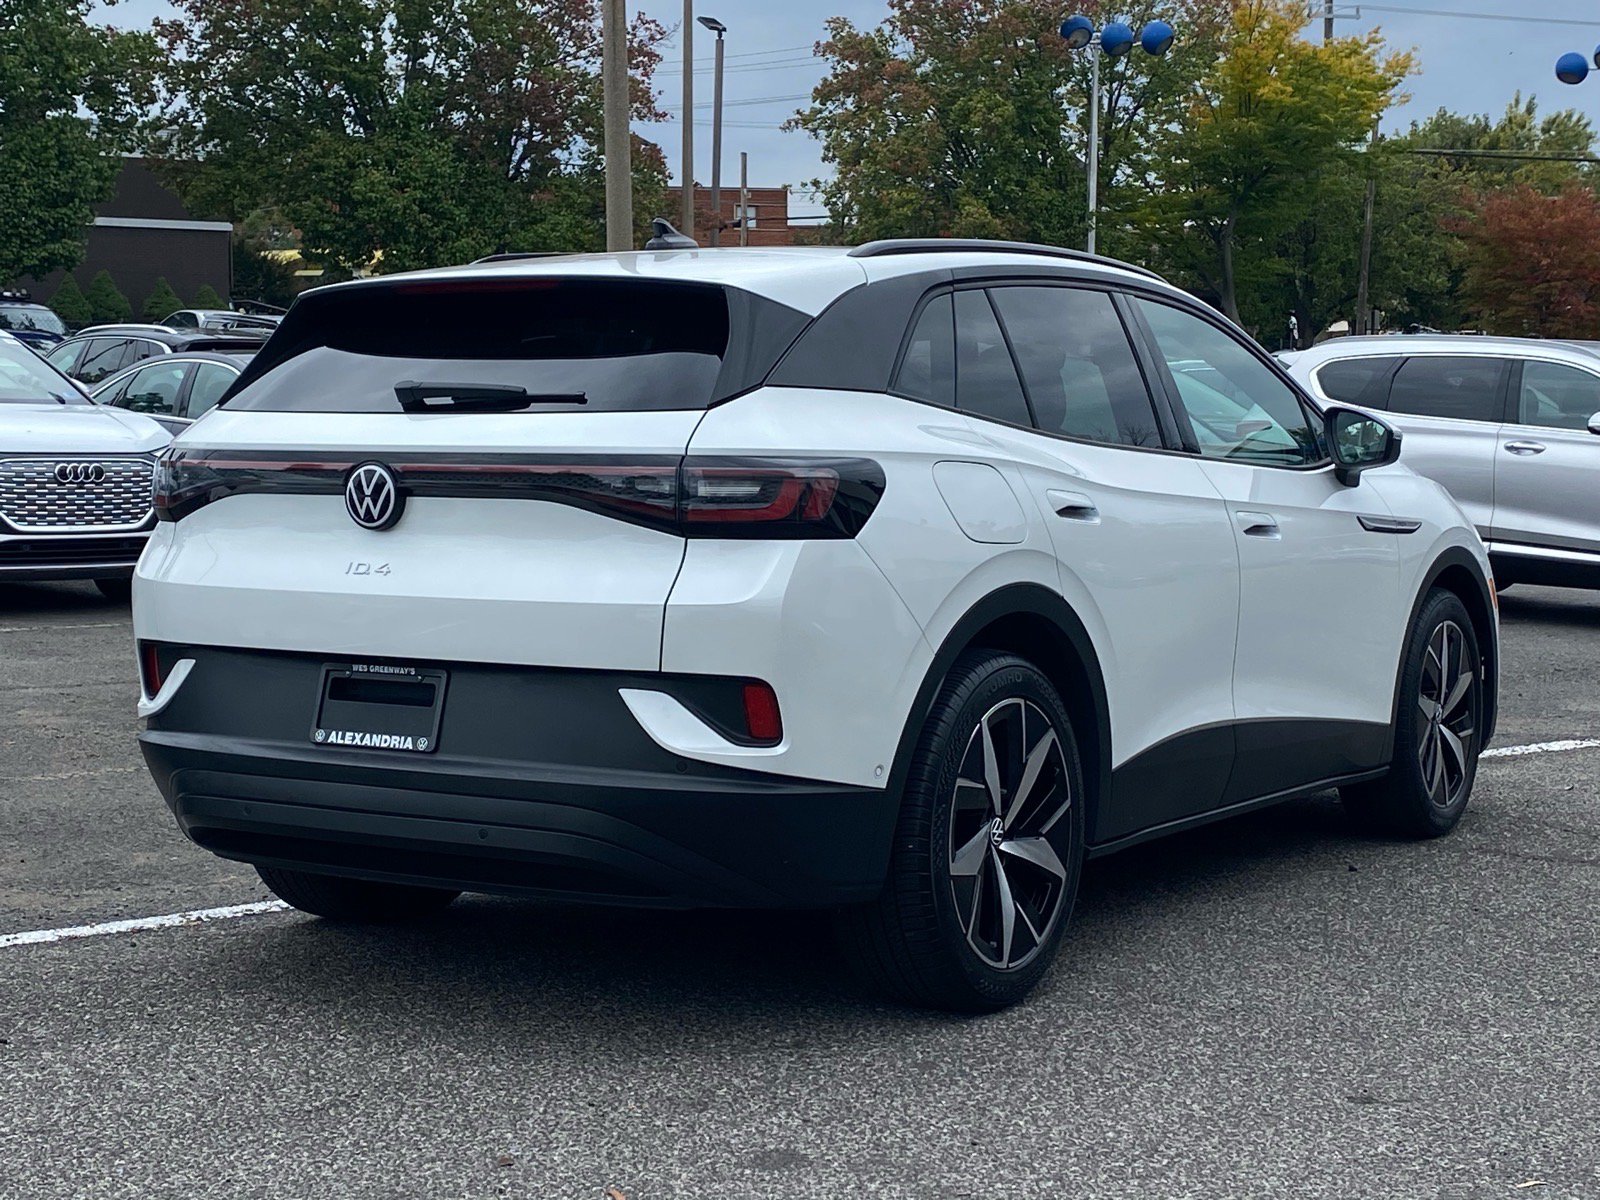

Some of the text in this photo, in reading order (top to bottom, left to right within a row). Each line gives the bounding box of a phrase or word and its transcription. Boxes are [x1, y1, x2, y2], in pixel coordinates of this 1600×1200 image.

[352, 664, 416, 675] WES GREENWAY'S
[327, 730, 413, 750] ALEXANDRIA
